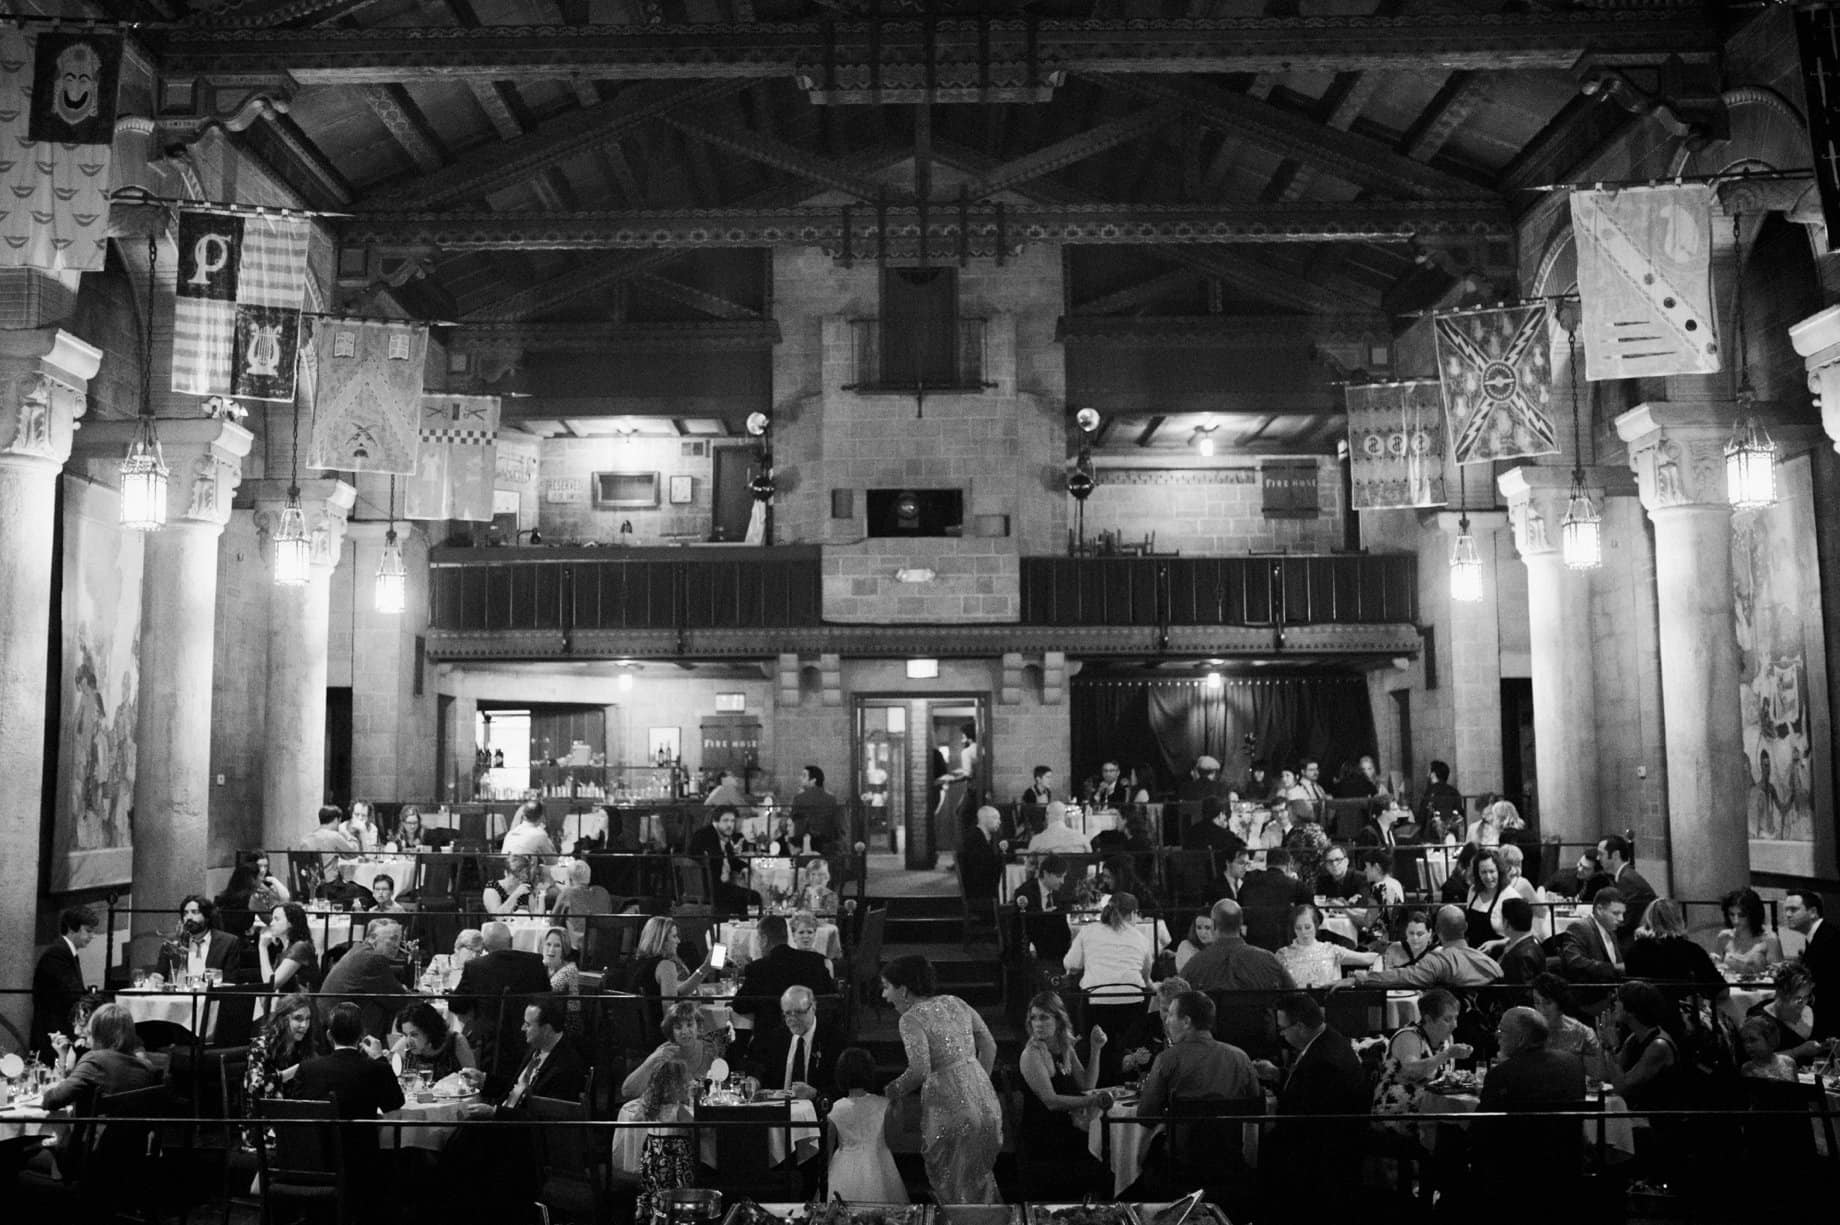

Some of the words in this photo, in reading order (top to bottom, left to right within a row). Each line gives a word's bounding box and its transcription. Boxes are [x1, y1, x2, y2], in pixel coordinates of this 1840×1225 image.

[187, 233, 231, 284] P
[1265, 478, 1289, 488] FIRE
[1292, 479, 1317, 488] HOSE
[703, 739, 728, 748] FIRE
[732, 740, 757, 748] HOSE
